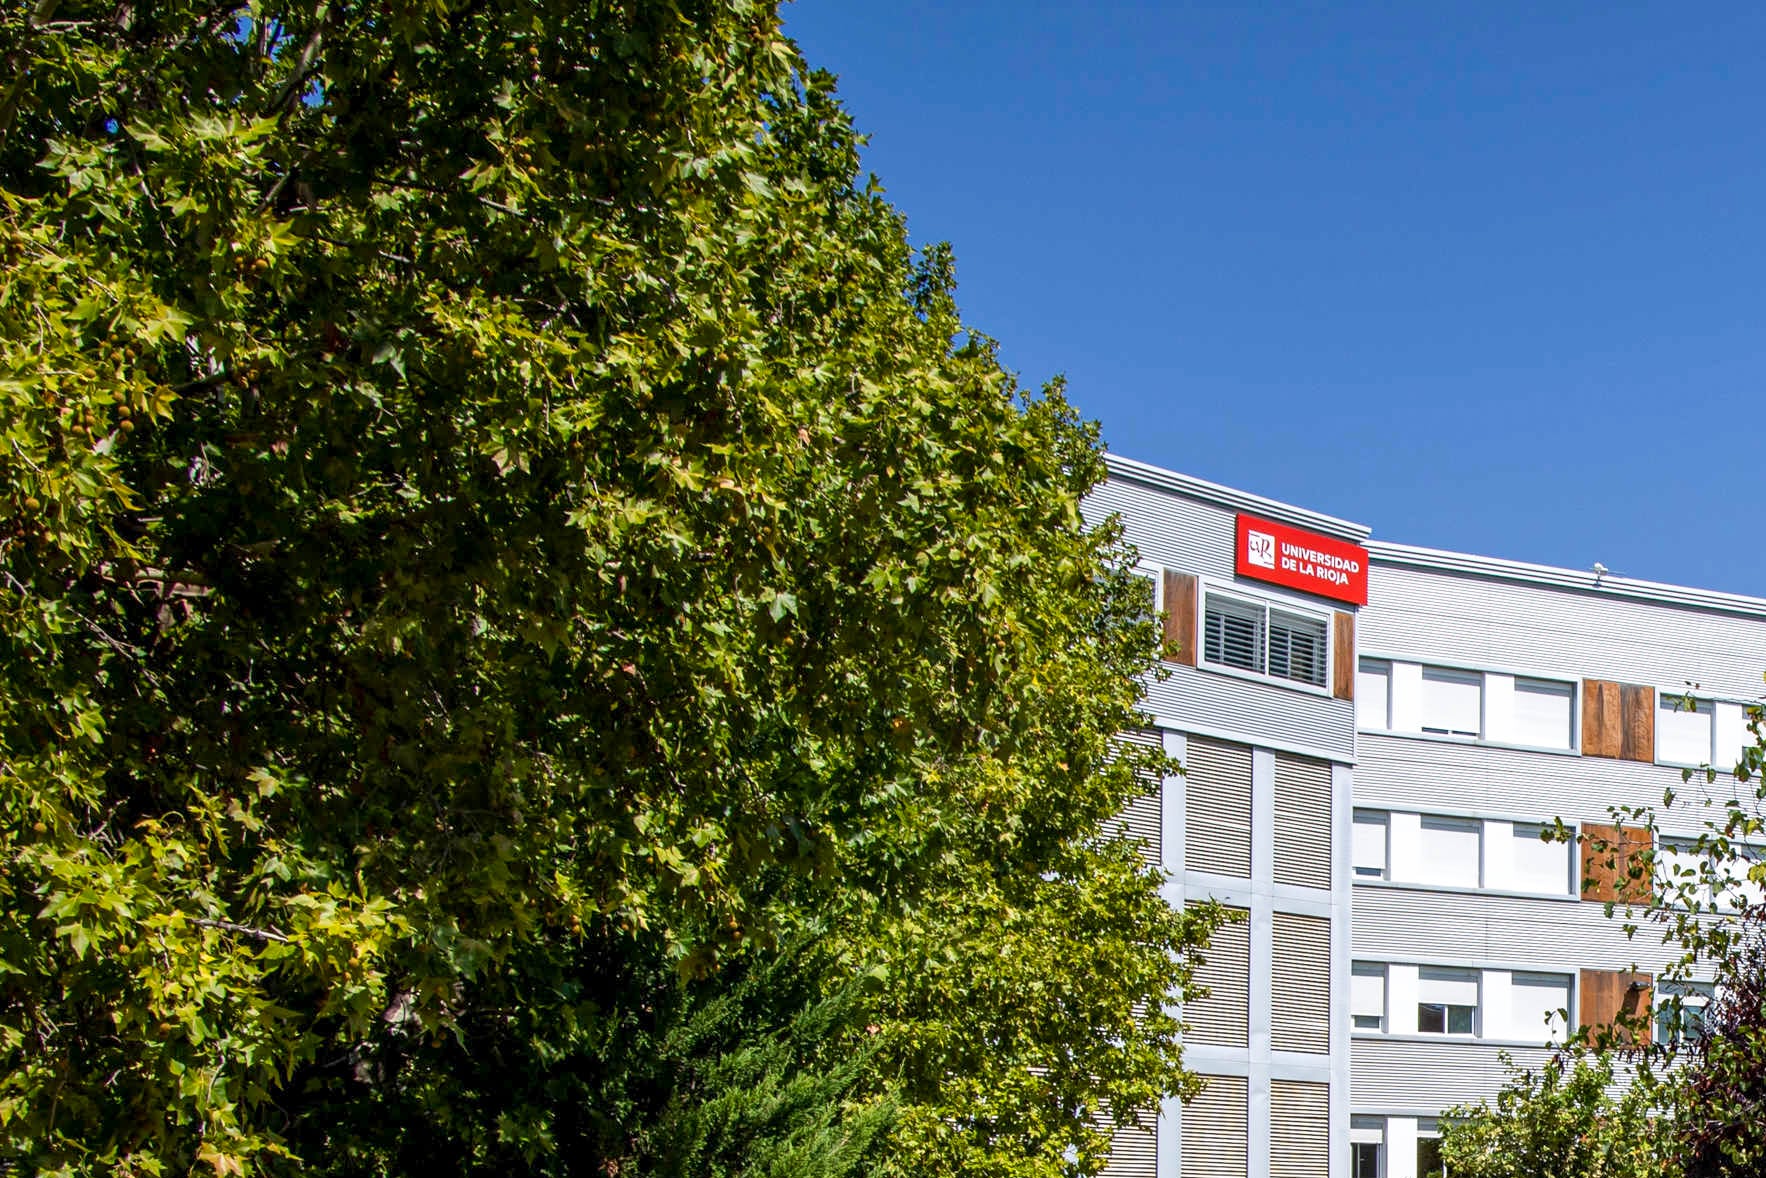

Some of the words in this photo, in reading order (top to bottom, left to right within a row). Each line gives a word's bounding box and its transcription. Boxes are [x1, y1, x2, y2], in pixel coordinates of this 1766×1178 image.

[1281, 542, 1360, 574] UNIVERSIDAD
[1281, 556, 1297, 572] DE
[1299, 561, 1315, 577] LA
[1316, 565, 1349, 586] RIOJA
